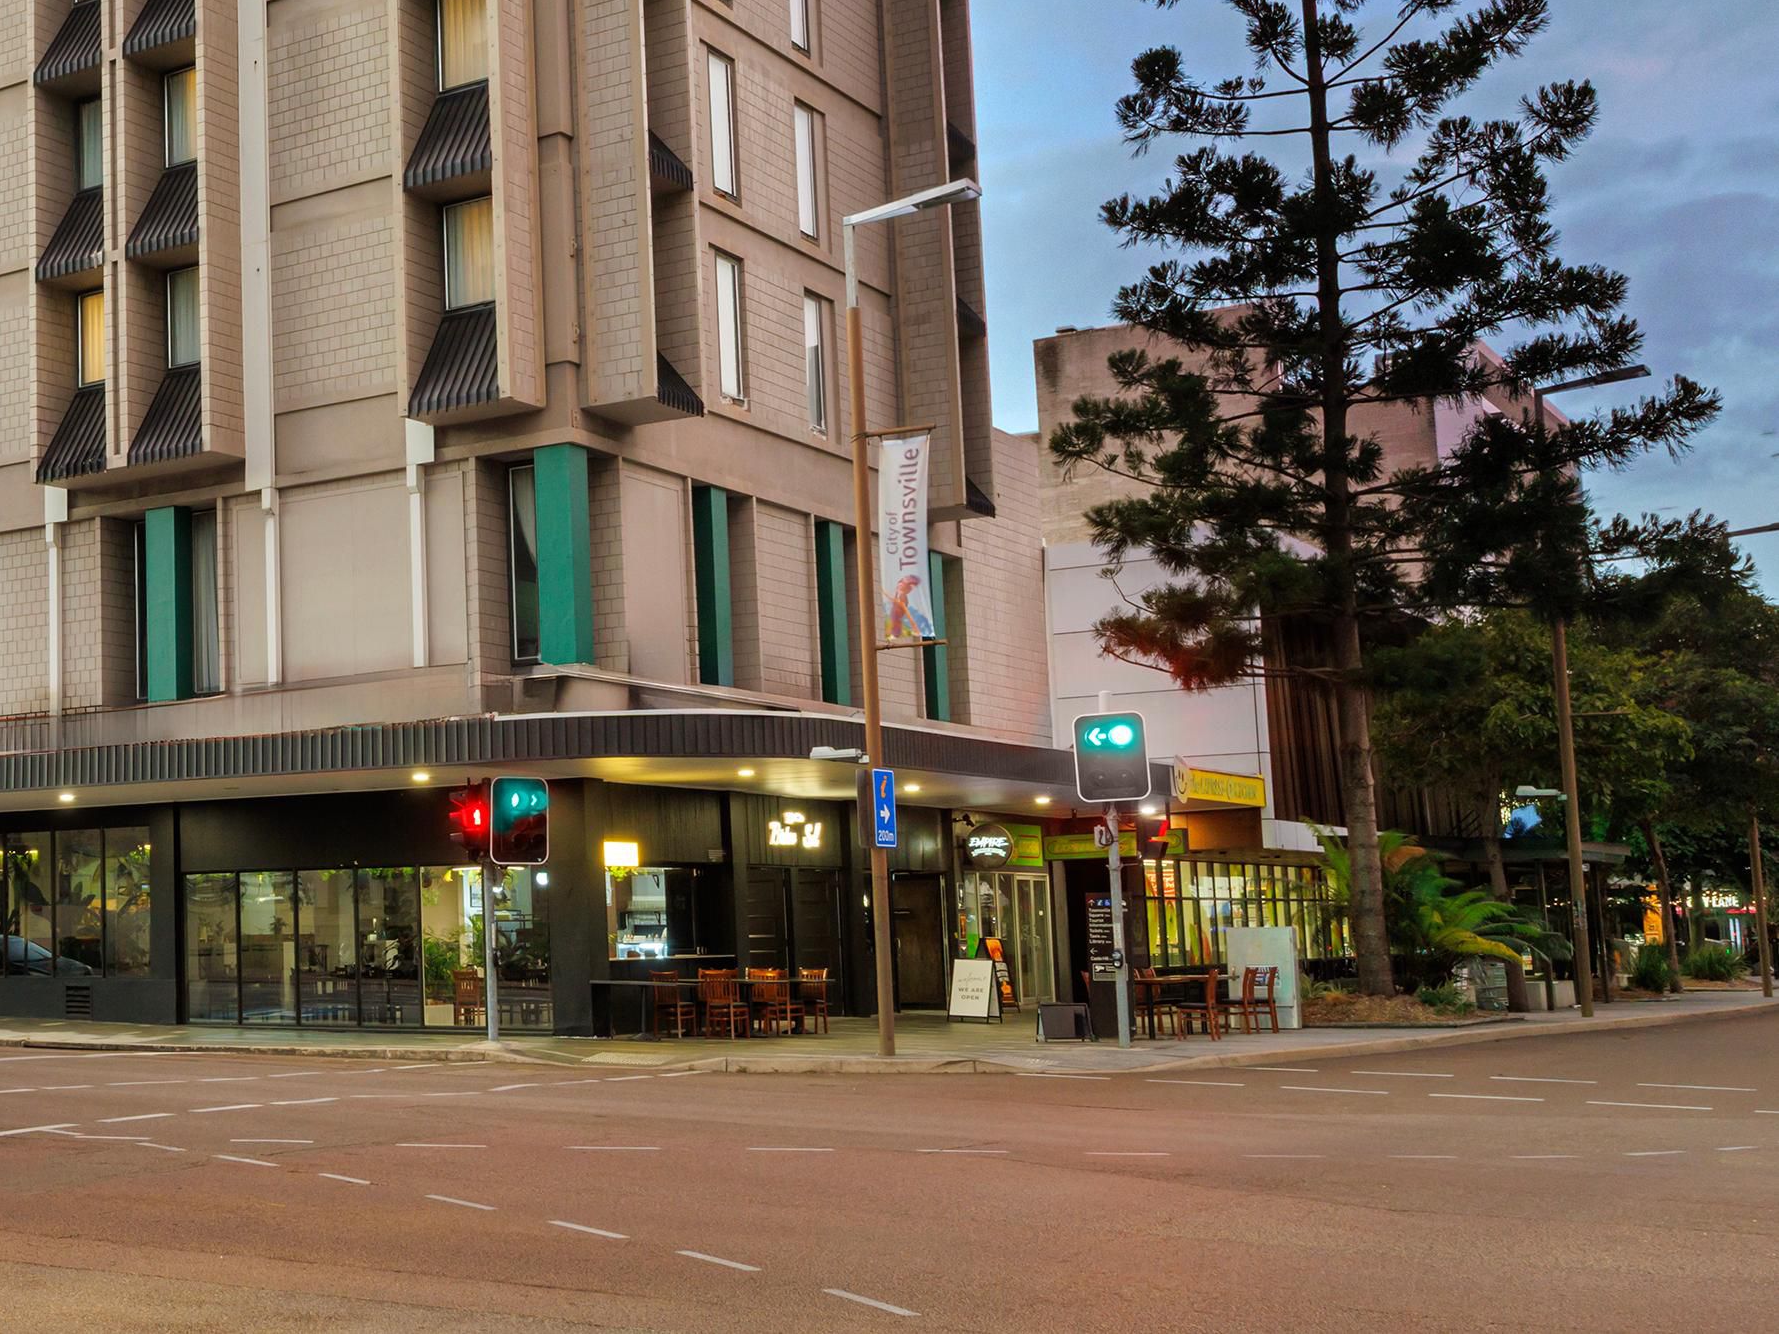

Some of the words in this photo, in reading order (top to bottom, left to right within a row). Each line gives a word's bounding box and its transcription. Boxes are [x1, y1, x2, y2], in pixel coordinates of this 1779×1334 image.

[898, 448, 920, 572] Townsville
[885, 510, 899, 524] of
[886, 528, 901, 555] City
[877, 830, 895, 842] 200m
[968, 836, 1009, 848] EMPIRE
[1711, 896, 1739, 907] LANE
